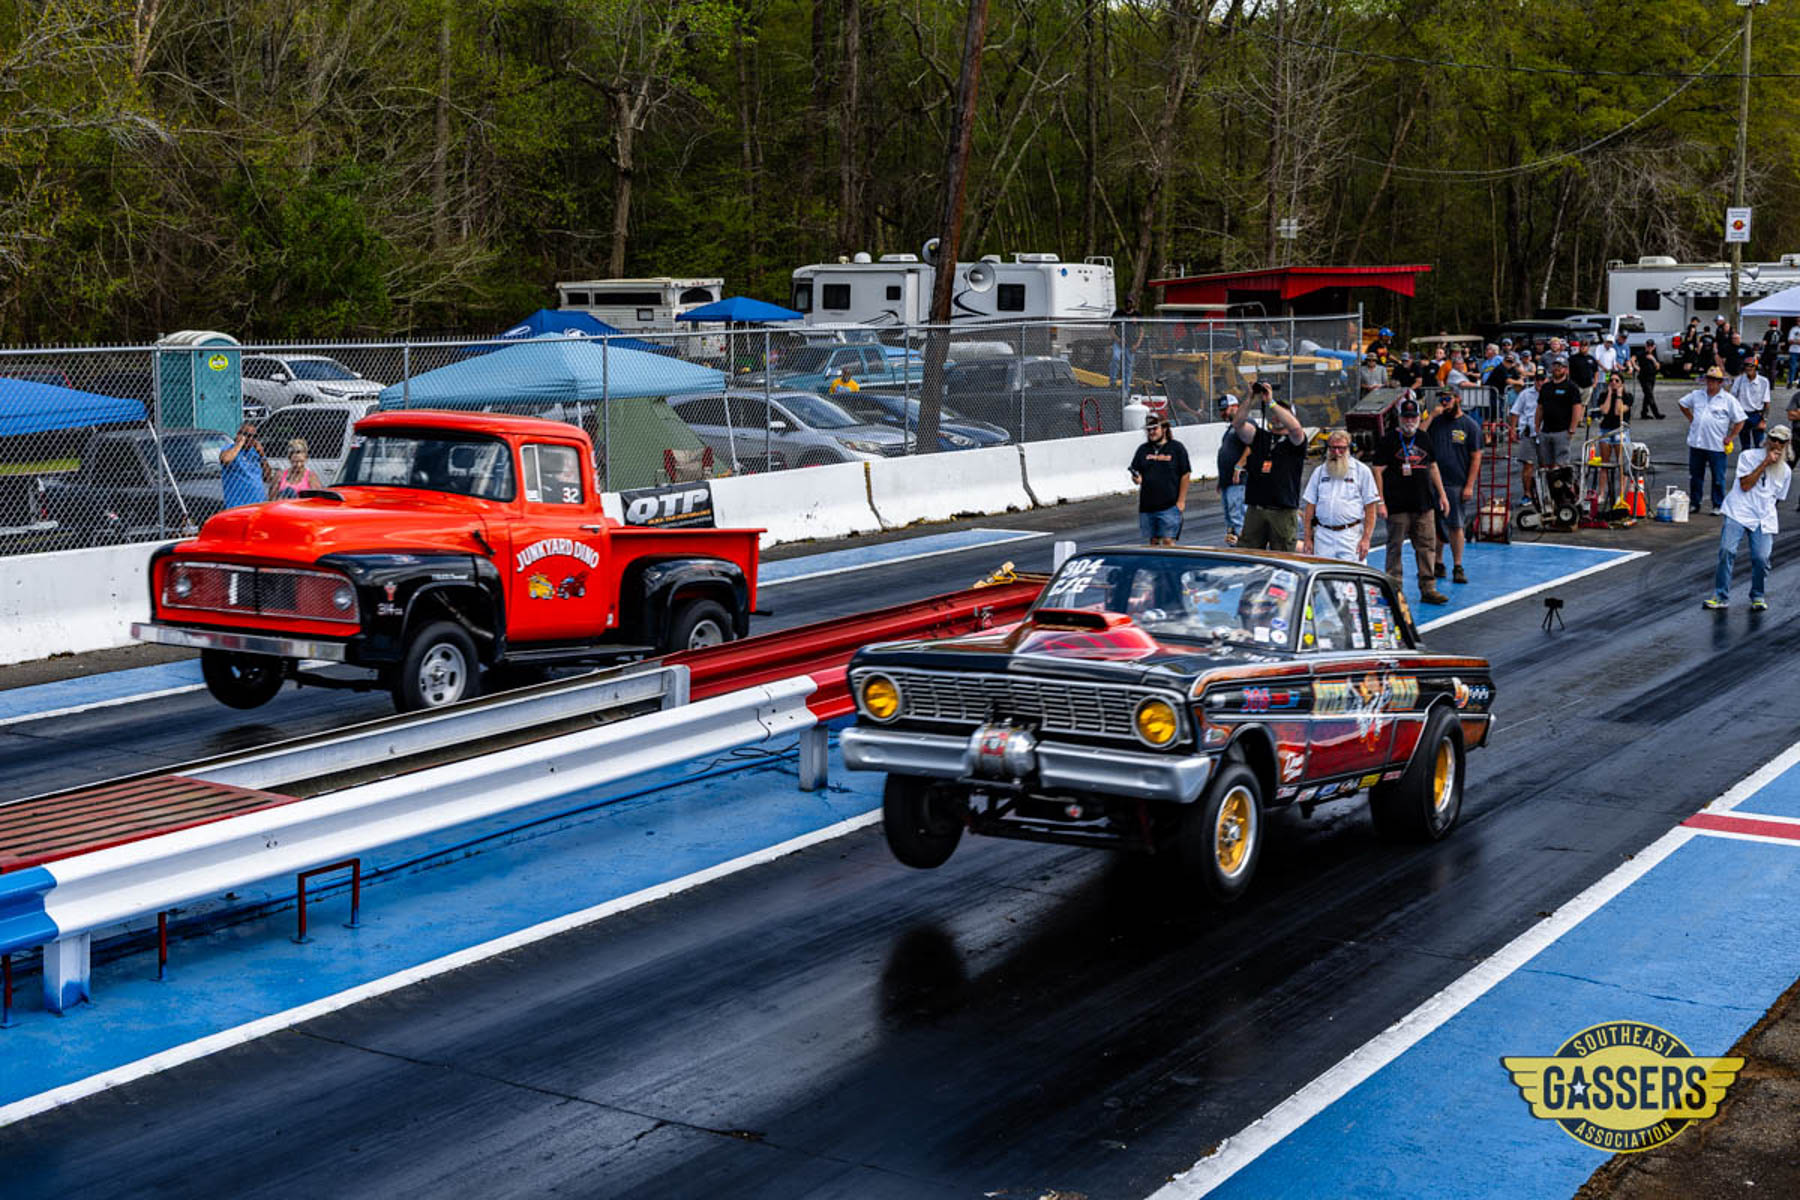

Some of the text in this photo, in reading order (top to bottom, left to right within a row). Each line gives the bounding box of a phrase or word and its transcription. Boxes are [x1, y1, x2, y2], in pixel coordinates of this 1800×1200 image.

[562, 487, 579, 503] 32
[626, 488, 709, 525] QTP
[516, 538, 599, 572] JUNKYARD DINO
[1061, 559, 1104, 577] 304
